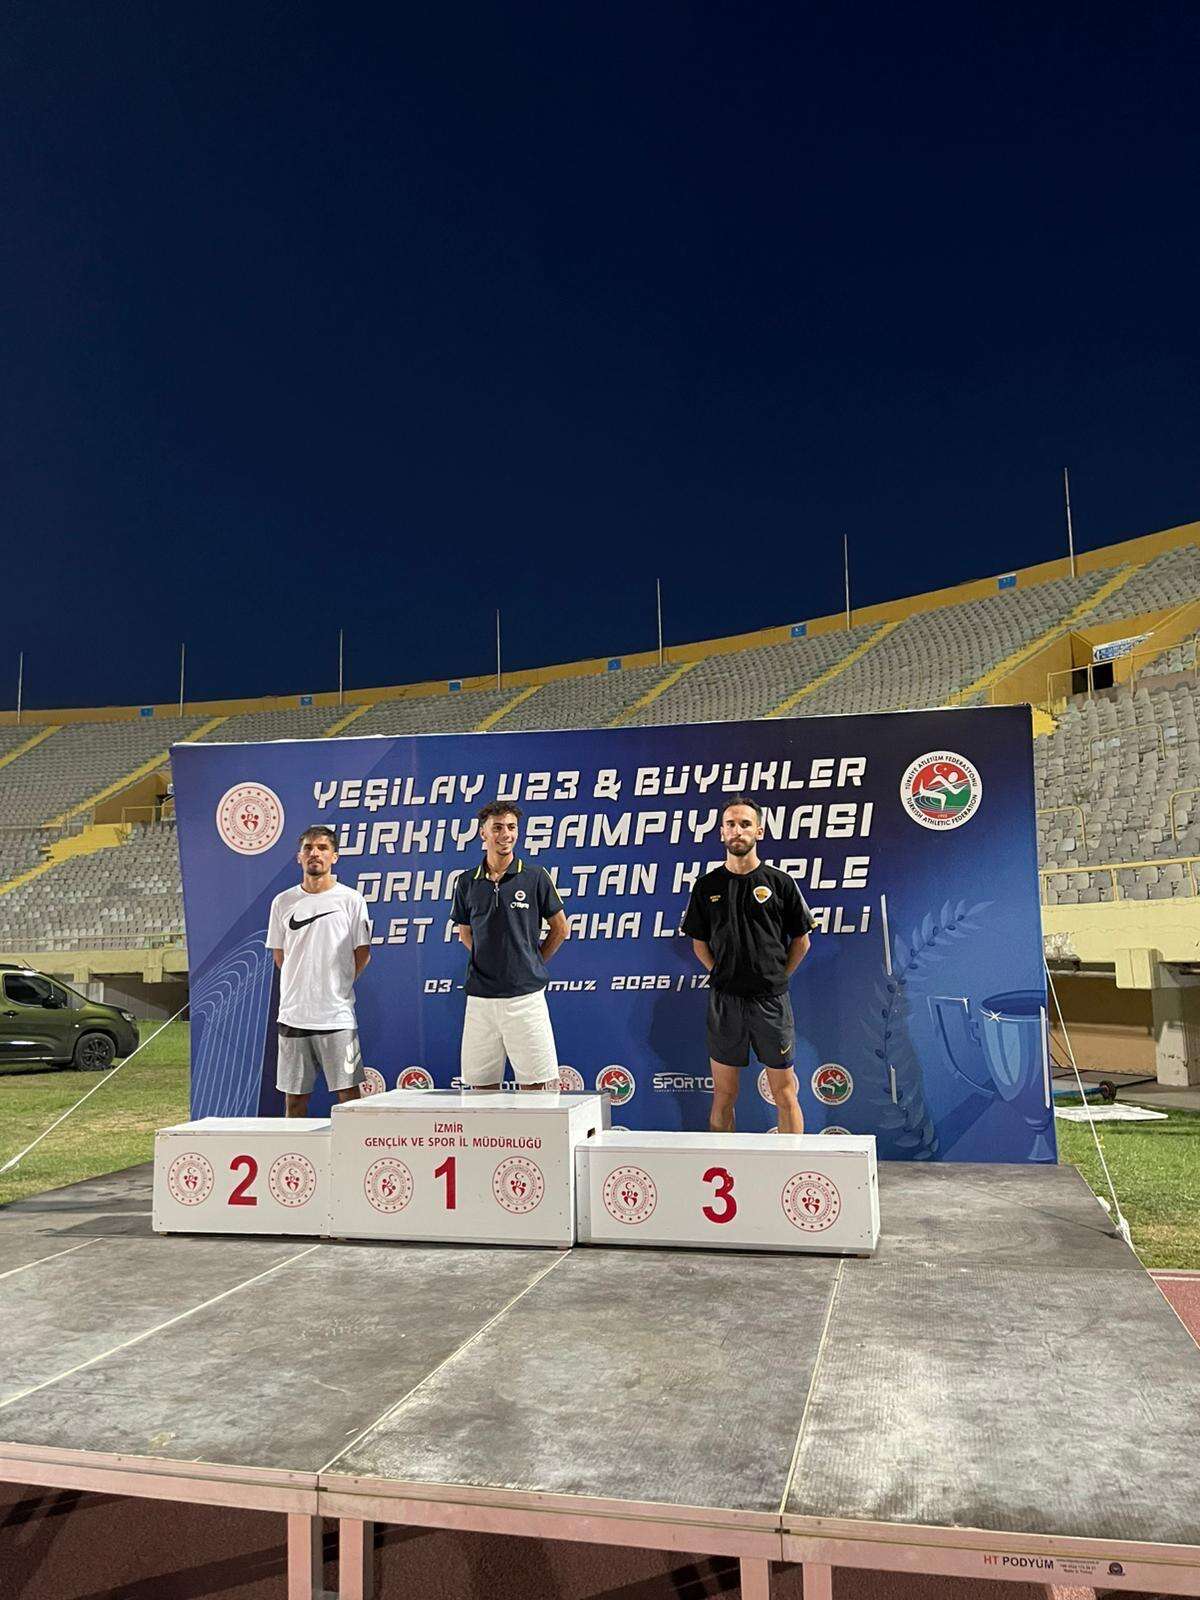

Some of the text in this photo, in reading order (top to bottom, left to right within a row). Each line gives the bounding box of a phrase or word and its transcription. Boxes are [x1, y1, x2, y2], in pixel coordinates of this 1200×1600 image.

[313, 756, 867, 812] YEŞİLAY U23 & BÜYÜKLER
[945, 755, 978, 787] FEDERASYONU
[952, 794, 979, 824] FEDERATION
[311, 818, 488, 857] ÜRKİY
[524, 802, 874, 856] ŞAMPİYNASI
[551, 863, 658, 897] LTAN
[423, 979, 453, 993] 03
[611, 975, 672, 991] 2026
[364, 1135, 542, 1149] GENÇLİK VE SPOR İL MÜDÜRLÜĞÜ
[434, 1121, 464, 1133] İZMİR
[227, 1154, 259, 1206] 2
[434, 1156, 457, 1210] 1
[702, 1167, 738, 1224] 3
[983, 1554, 1000, 1566] HT
[1002, 1556, 1055, 1570] PODYUM
